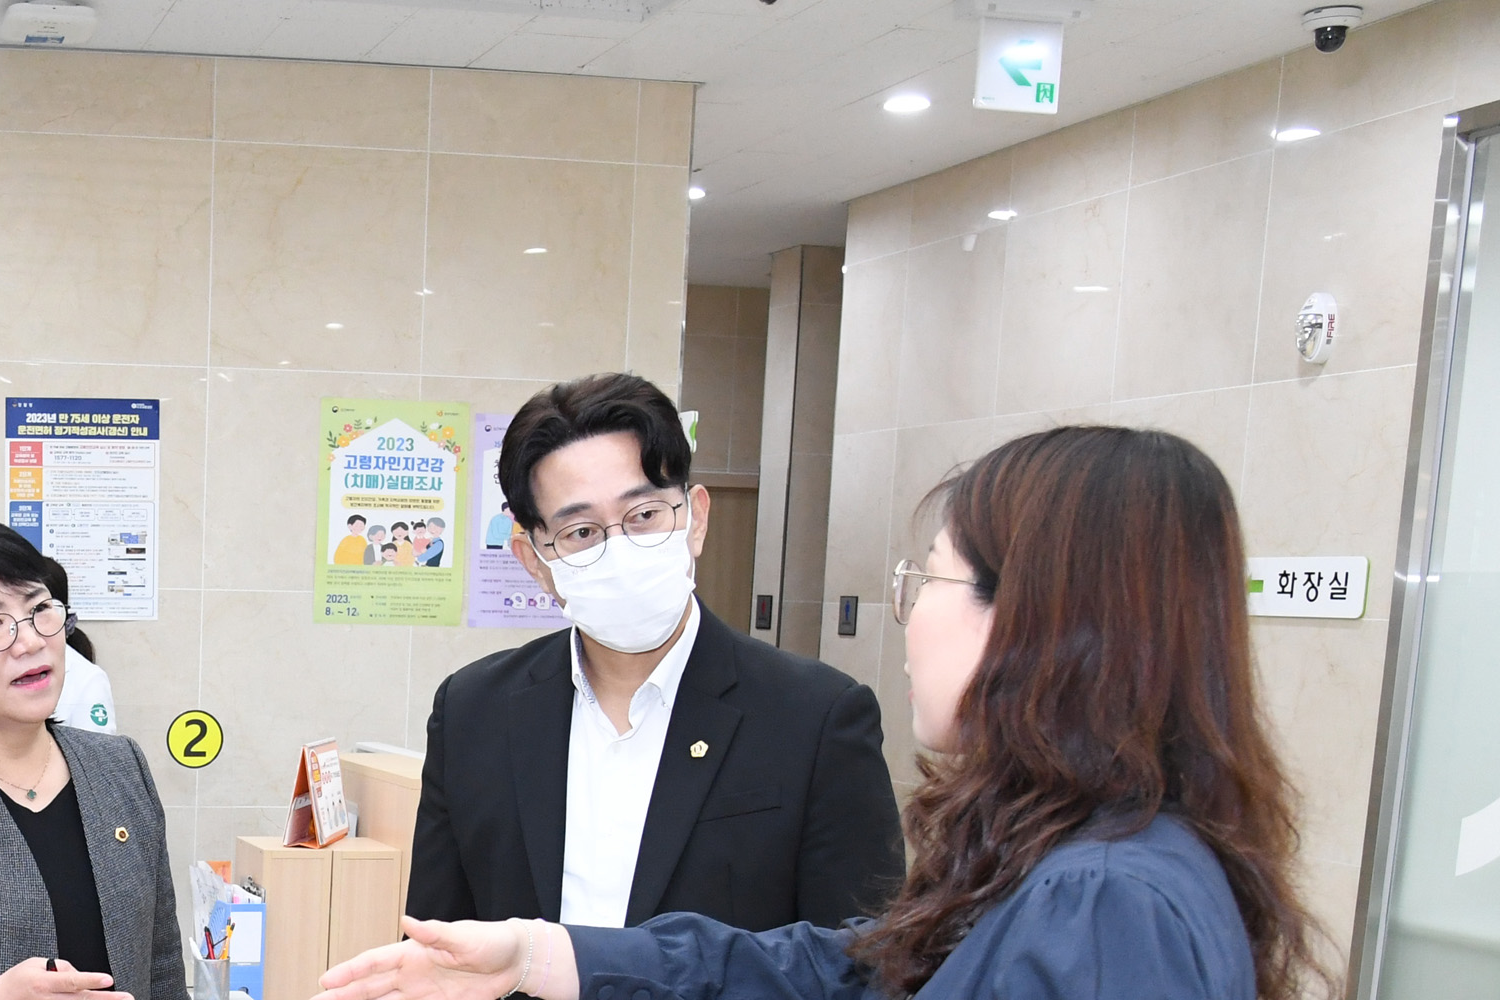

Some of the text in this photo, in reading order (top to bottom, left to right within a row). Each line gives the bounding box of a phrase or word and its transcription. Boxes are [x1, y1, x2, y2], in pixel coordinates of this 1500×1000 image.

[1326, 313, 1336, 338] FIRE
[377, 436, 415, 452] 2023
[343, 454, 445, 473] 고령자인지건강
[344, 473, 444, 492] (치매)실태조사
[1277, 570, 1350, 603] 화장실
[183, 719, 208, 758] 2
